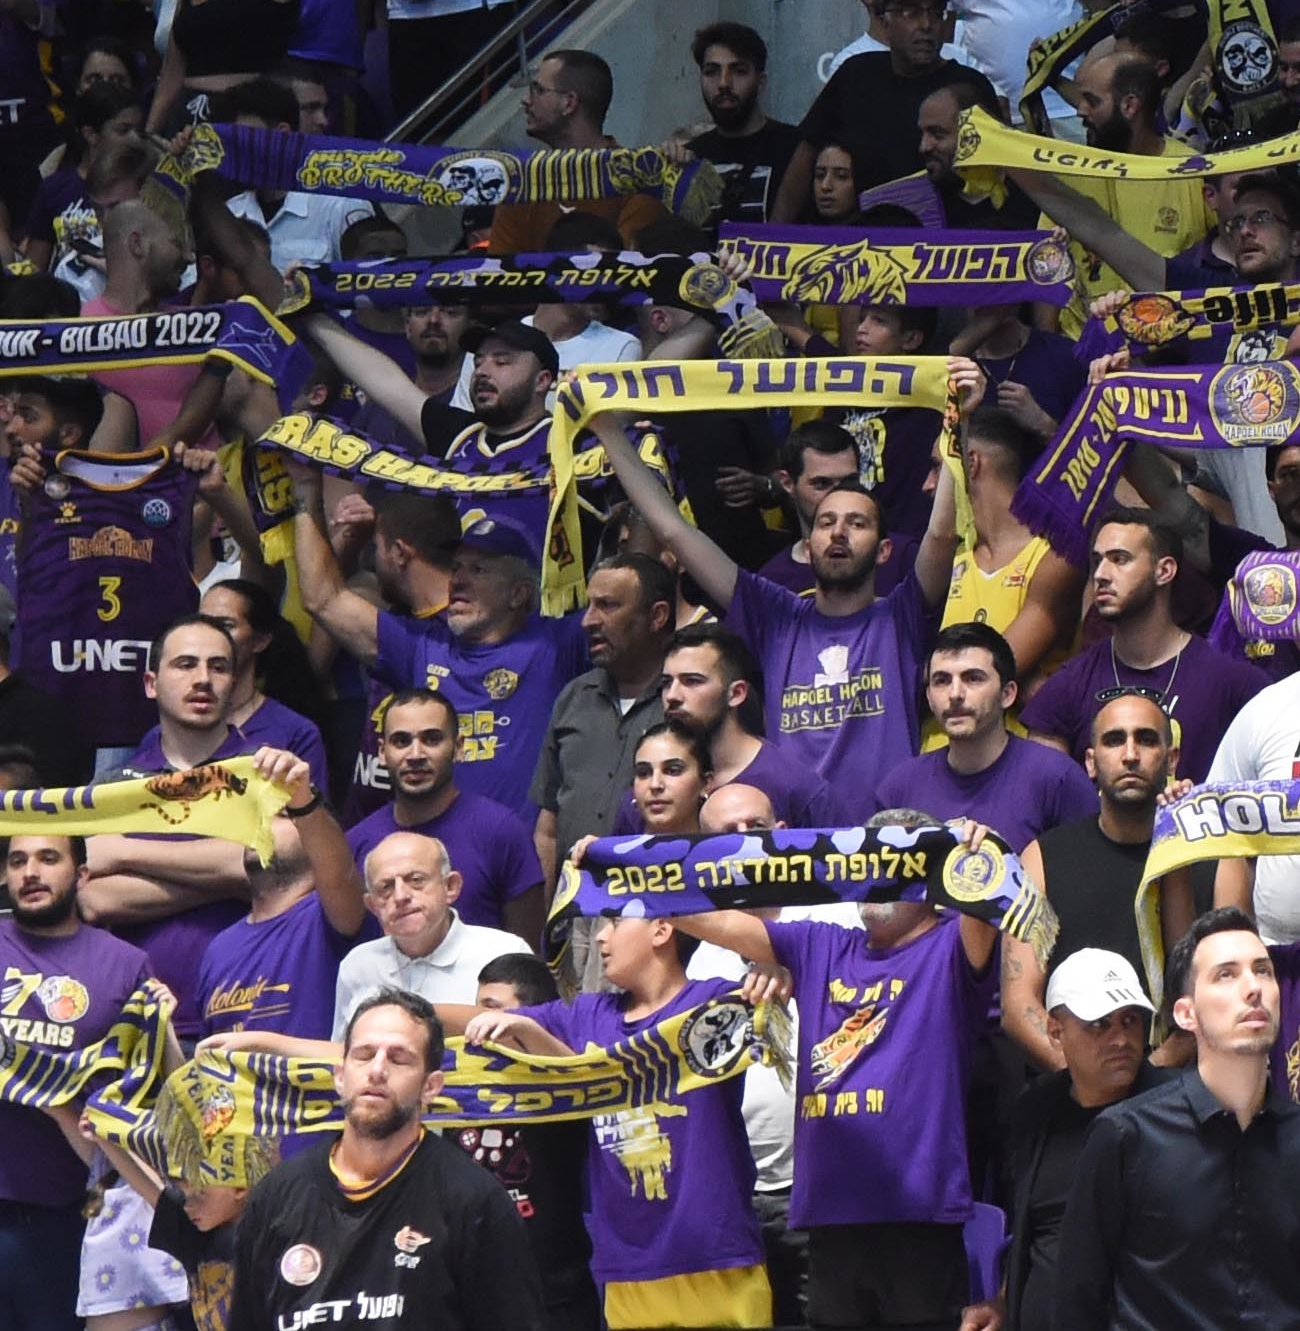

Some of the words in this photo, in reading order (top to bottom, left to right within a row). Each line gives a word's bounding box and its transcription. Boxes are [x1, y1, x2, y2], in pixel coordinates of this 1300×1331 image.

[299, 166, 463, 207] BROTHERS
[425, 270, 548, 290] המדינה
[555, 269, 658, 289] אלופת
[911, 241, 1017, 283] הפועל
[335, 272, 417, 292] 2022
[1204, 278, 1298, 327] life
[60, 315, 150, 353] BILBAO
[154, 312, 222, 347] 2022
[716, 357, 914, 399] הפועל
[96, 575, 120, 622] 3
[780, 682, 836, 709] HAPOEL
[838, 671, 882, 701] HOLON
[780, 694, 885, 731] BASKETBALL
[607, 866, 685, 896] 2022
[696, 847, 803, 892] המדינה
[826, 847, 927, 883] אלופת
[489, 1080, 624, 1114] פרפל
